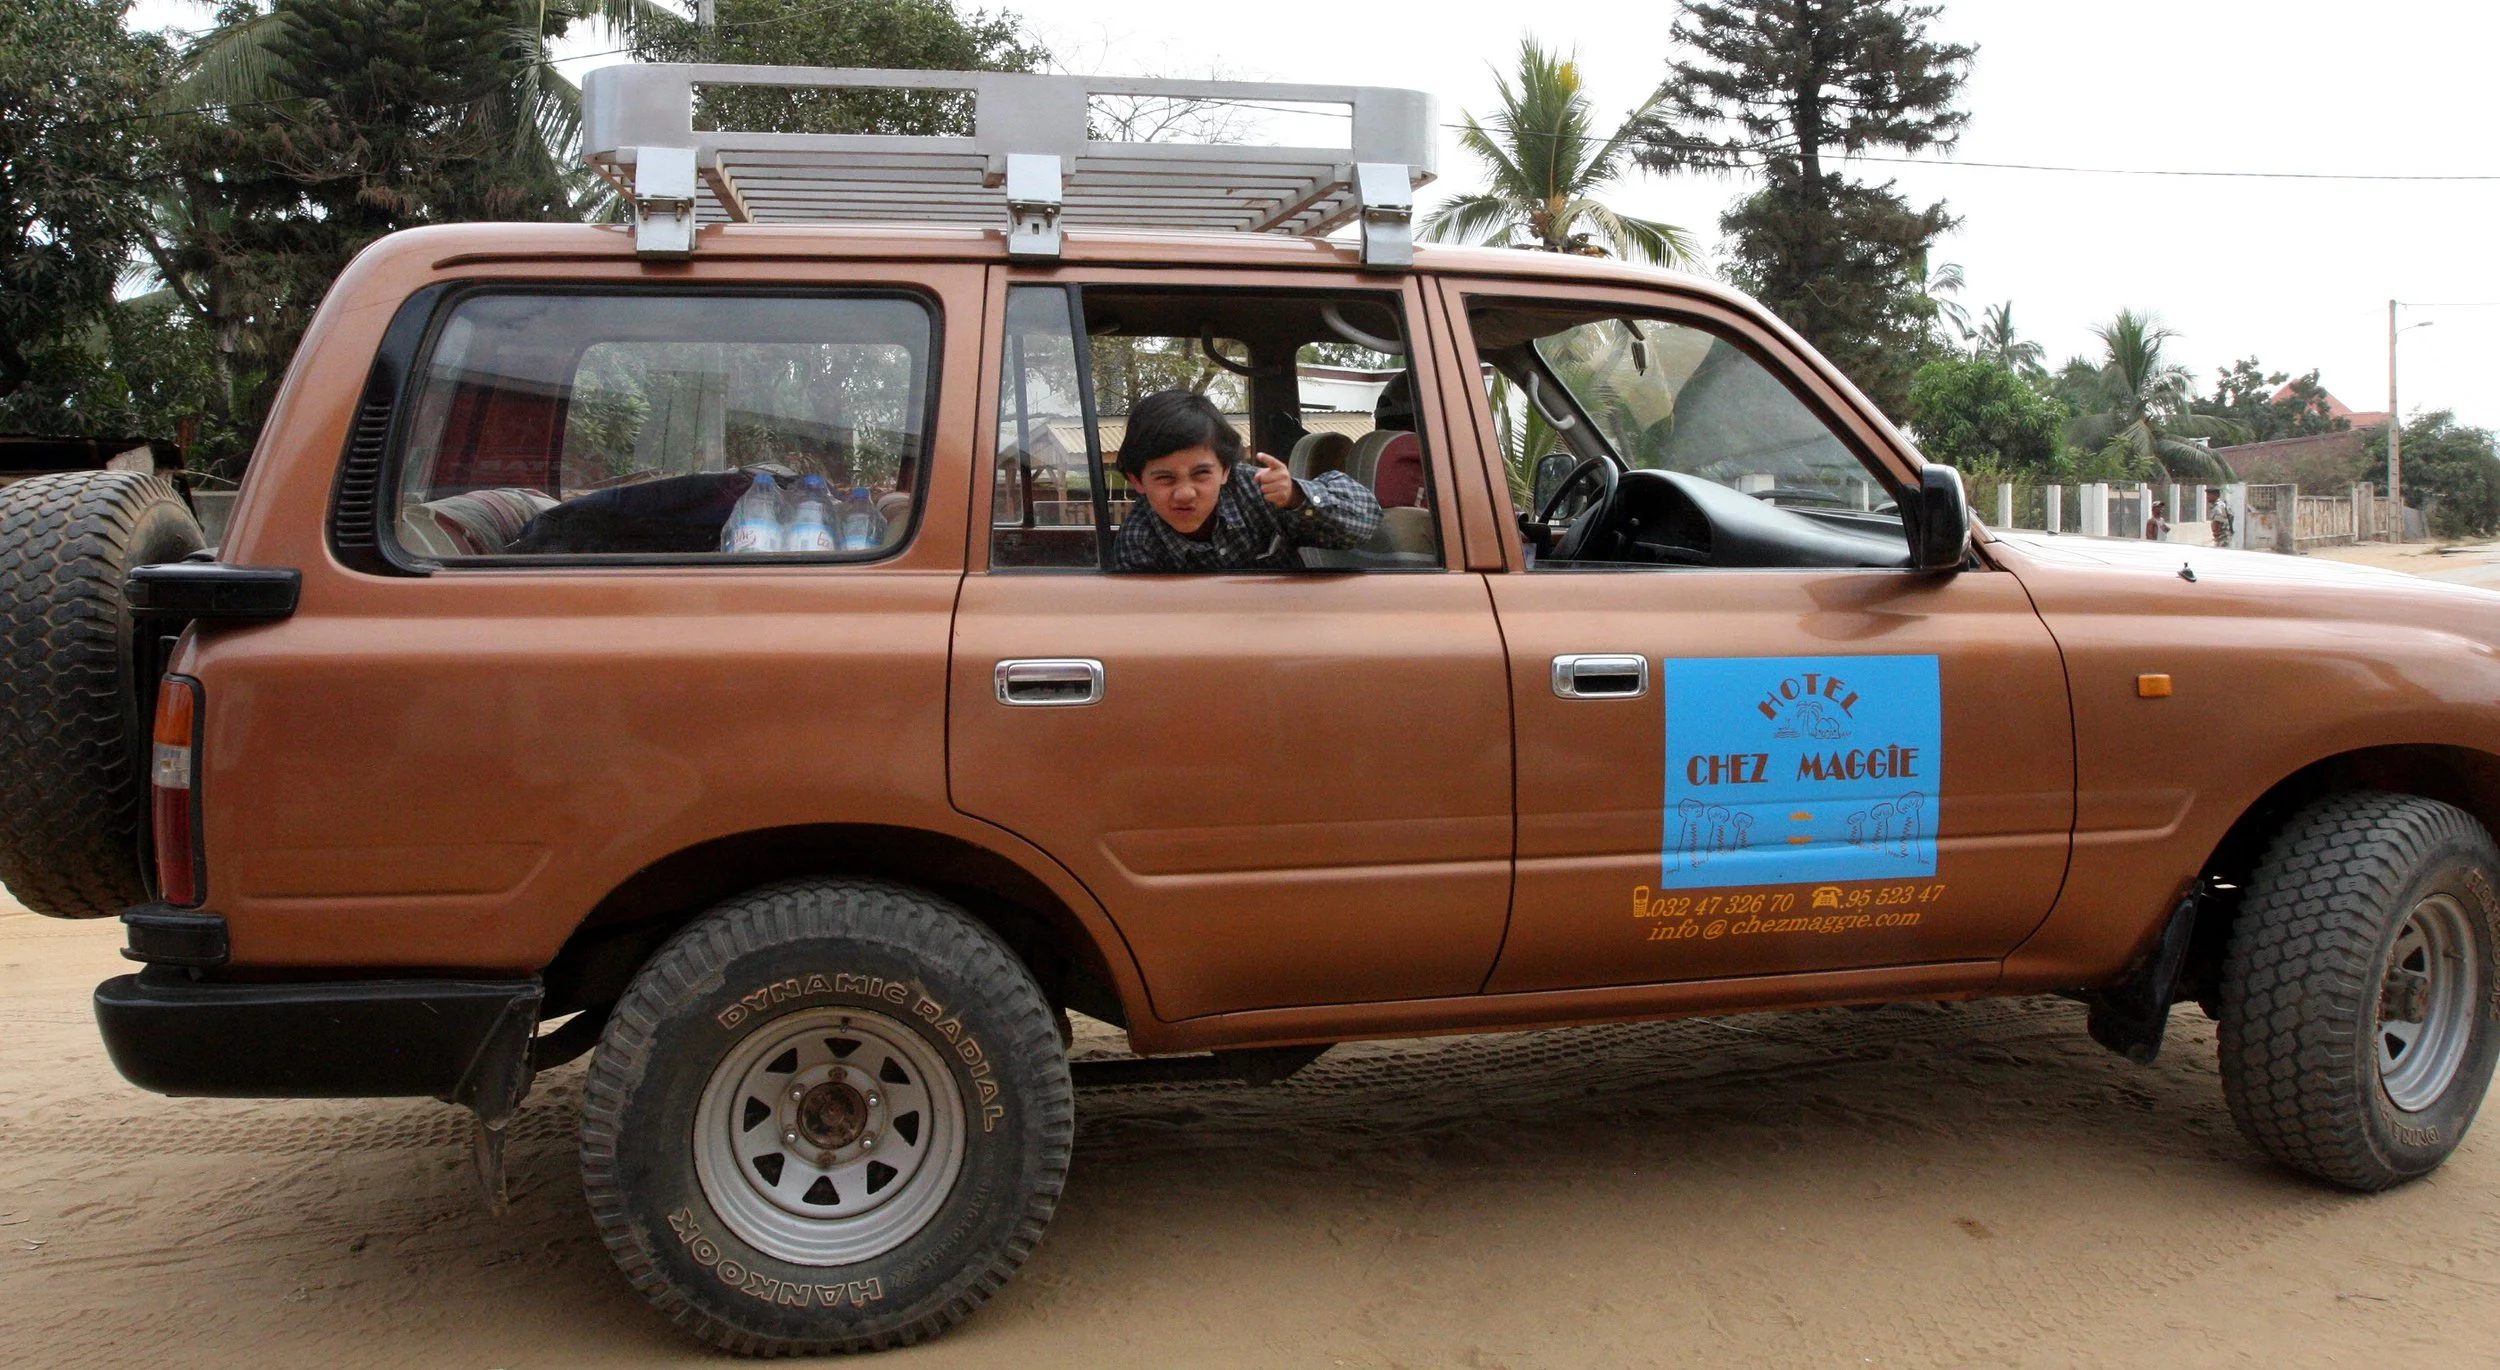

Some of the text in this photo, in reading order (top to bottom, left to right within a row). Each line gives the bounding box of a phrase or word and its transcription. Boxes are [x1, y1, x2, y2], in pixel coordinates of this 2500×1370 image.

[1757, 673, 1860, 721] HOTEL
[1686, 753, 1769, 787] CHEZ
[1695, 896, 1723, 916] 47
[1724, 894, 1766, 915] 326
[1770, 892, 1795, 913] 70
[1875, 885, 1916, 906] 523
[1918, 884, 1946, 903] 47
[1647, 918, 1700, 941] info
[717, 972, 1005, 1134] DYNAMIC RADIAL
[667, 1206, 884, 1308] HANKOOK
